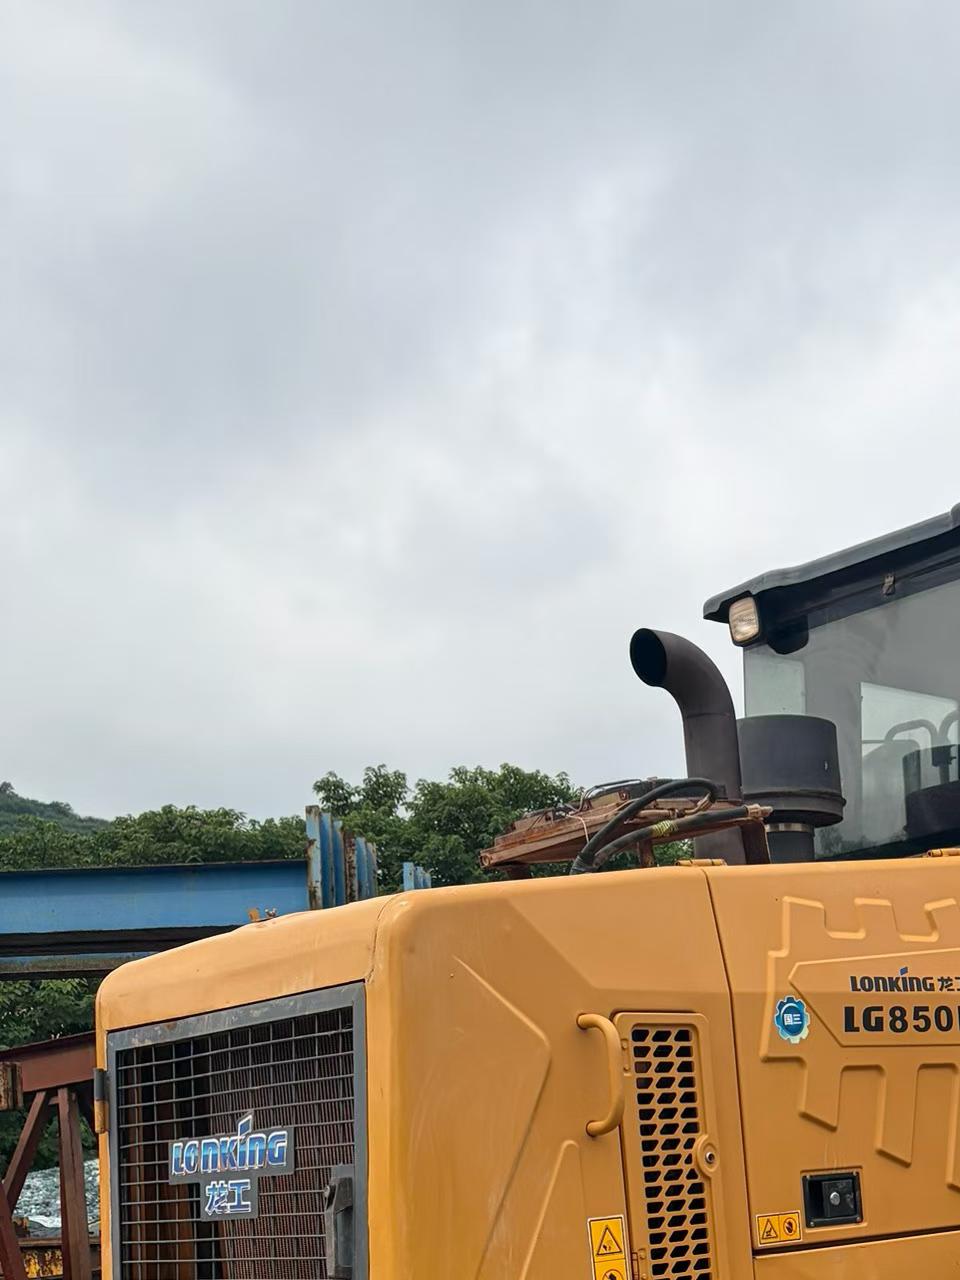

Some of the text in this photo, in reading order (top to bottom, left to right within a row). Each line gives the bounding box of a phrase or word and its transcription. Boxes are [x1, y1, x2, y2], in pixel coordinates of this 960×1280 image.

[850, 966, 935, 992] LONKING
[172, 1114, 288, 1176] LONKING
[205, 1179, 251, 1215] 龙工
